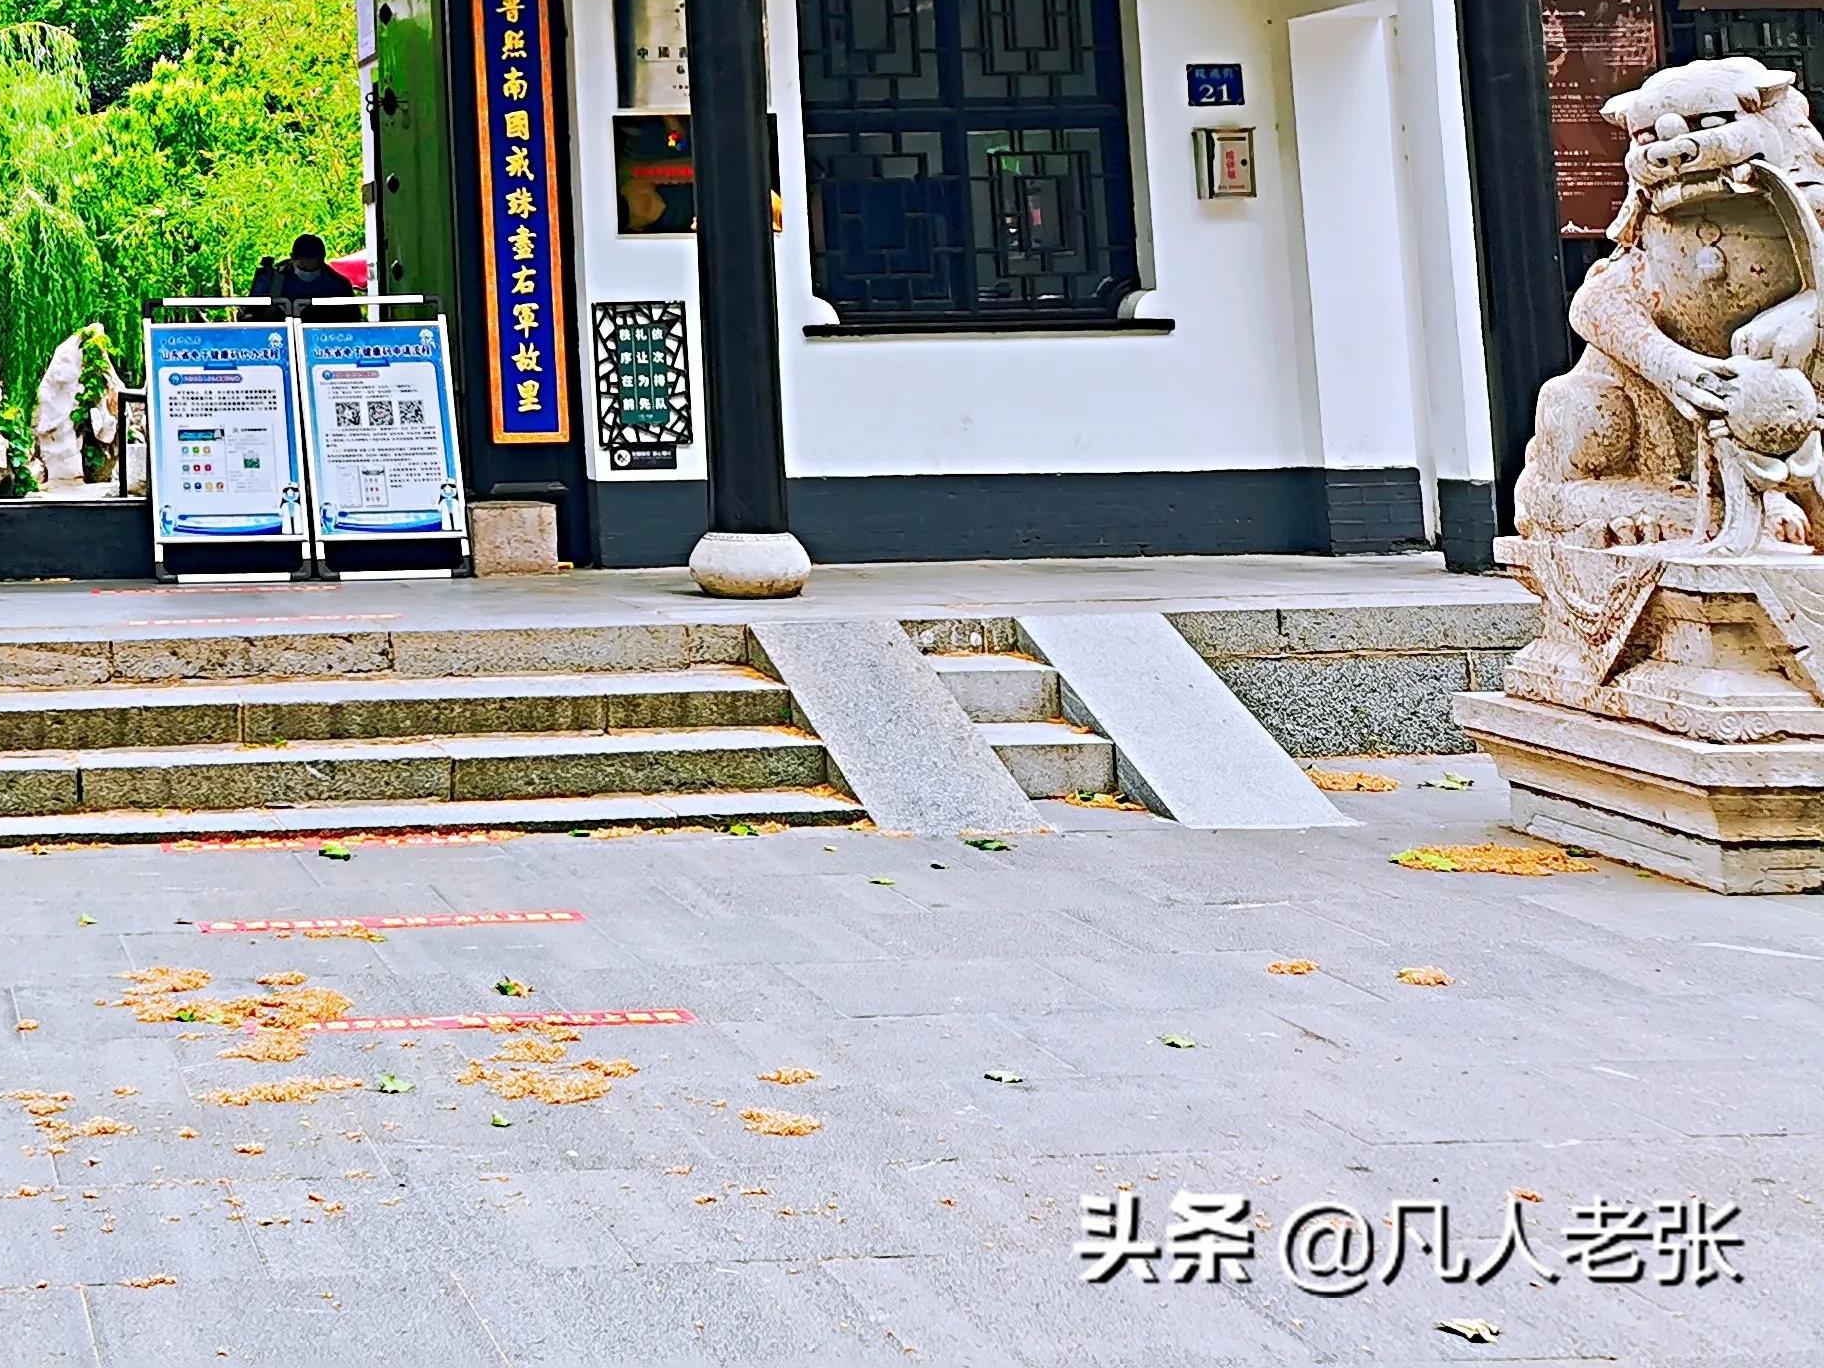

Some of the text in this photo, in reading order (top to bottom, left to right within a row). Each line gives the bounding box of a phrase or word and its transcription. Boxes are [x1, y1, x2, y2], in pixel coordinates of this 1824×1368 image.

[1198, 83, 1231, 103] 21
[619, 328, 636, 412] 秩序在前
[634, 327, 652, 412] 礼让为先
[651, 327, 668, 411] 依次排队
